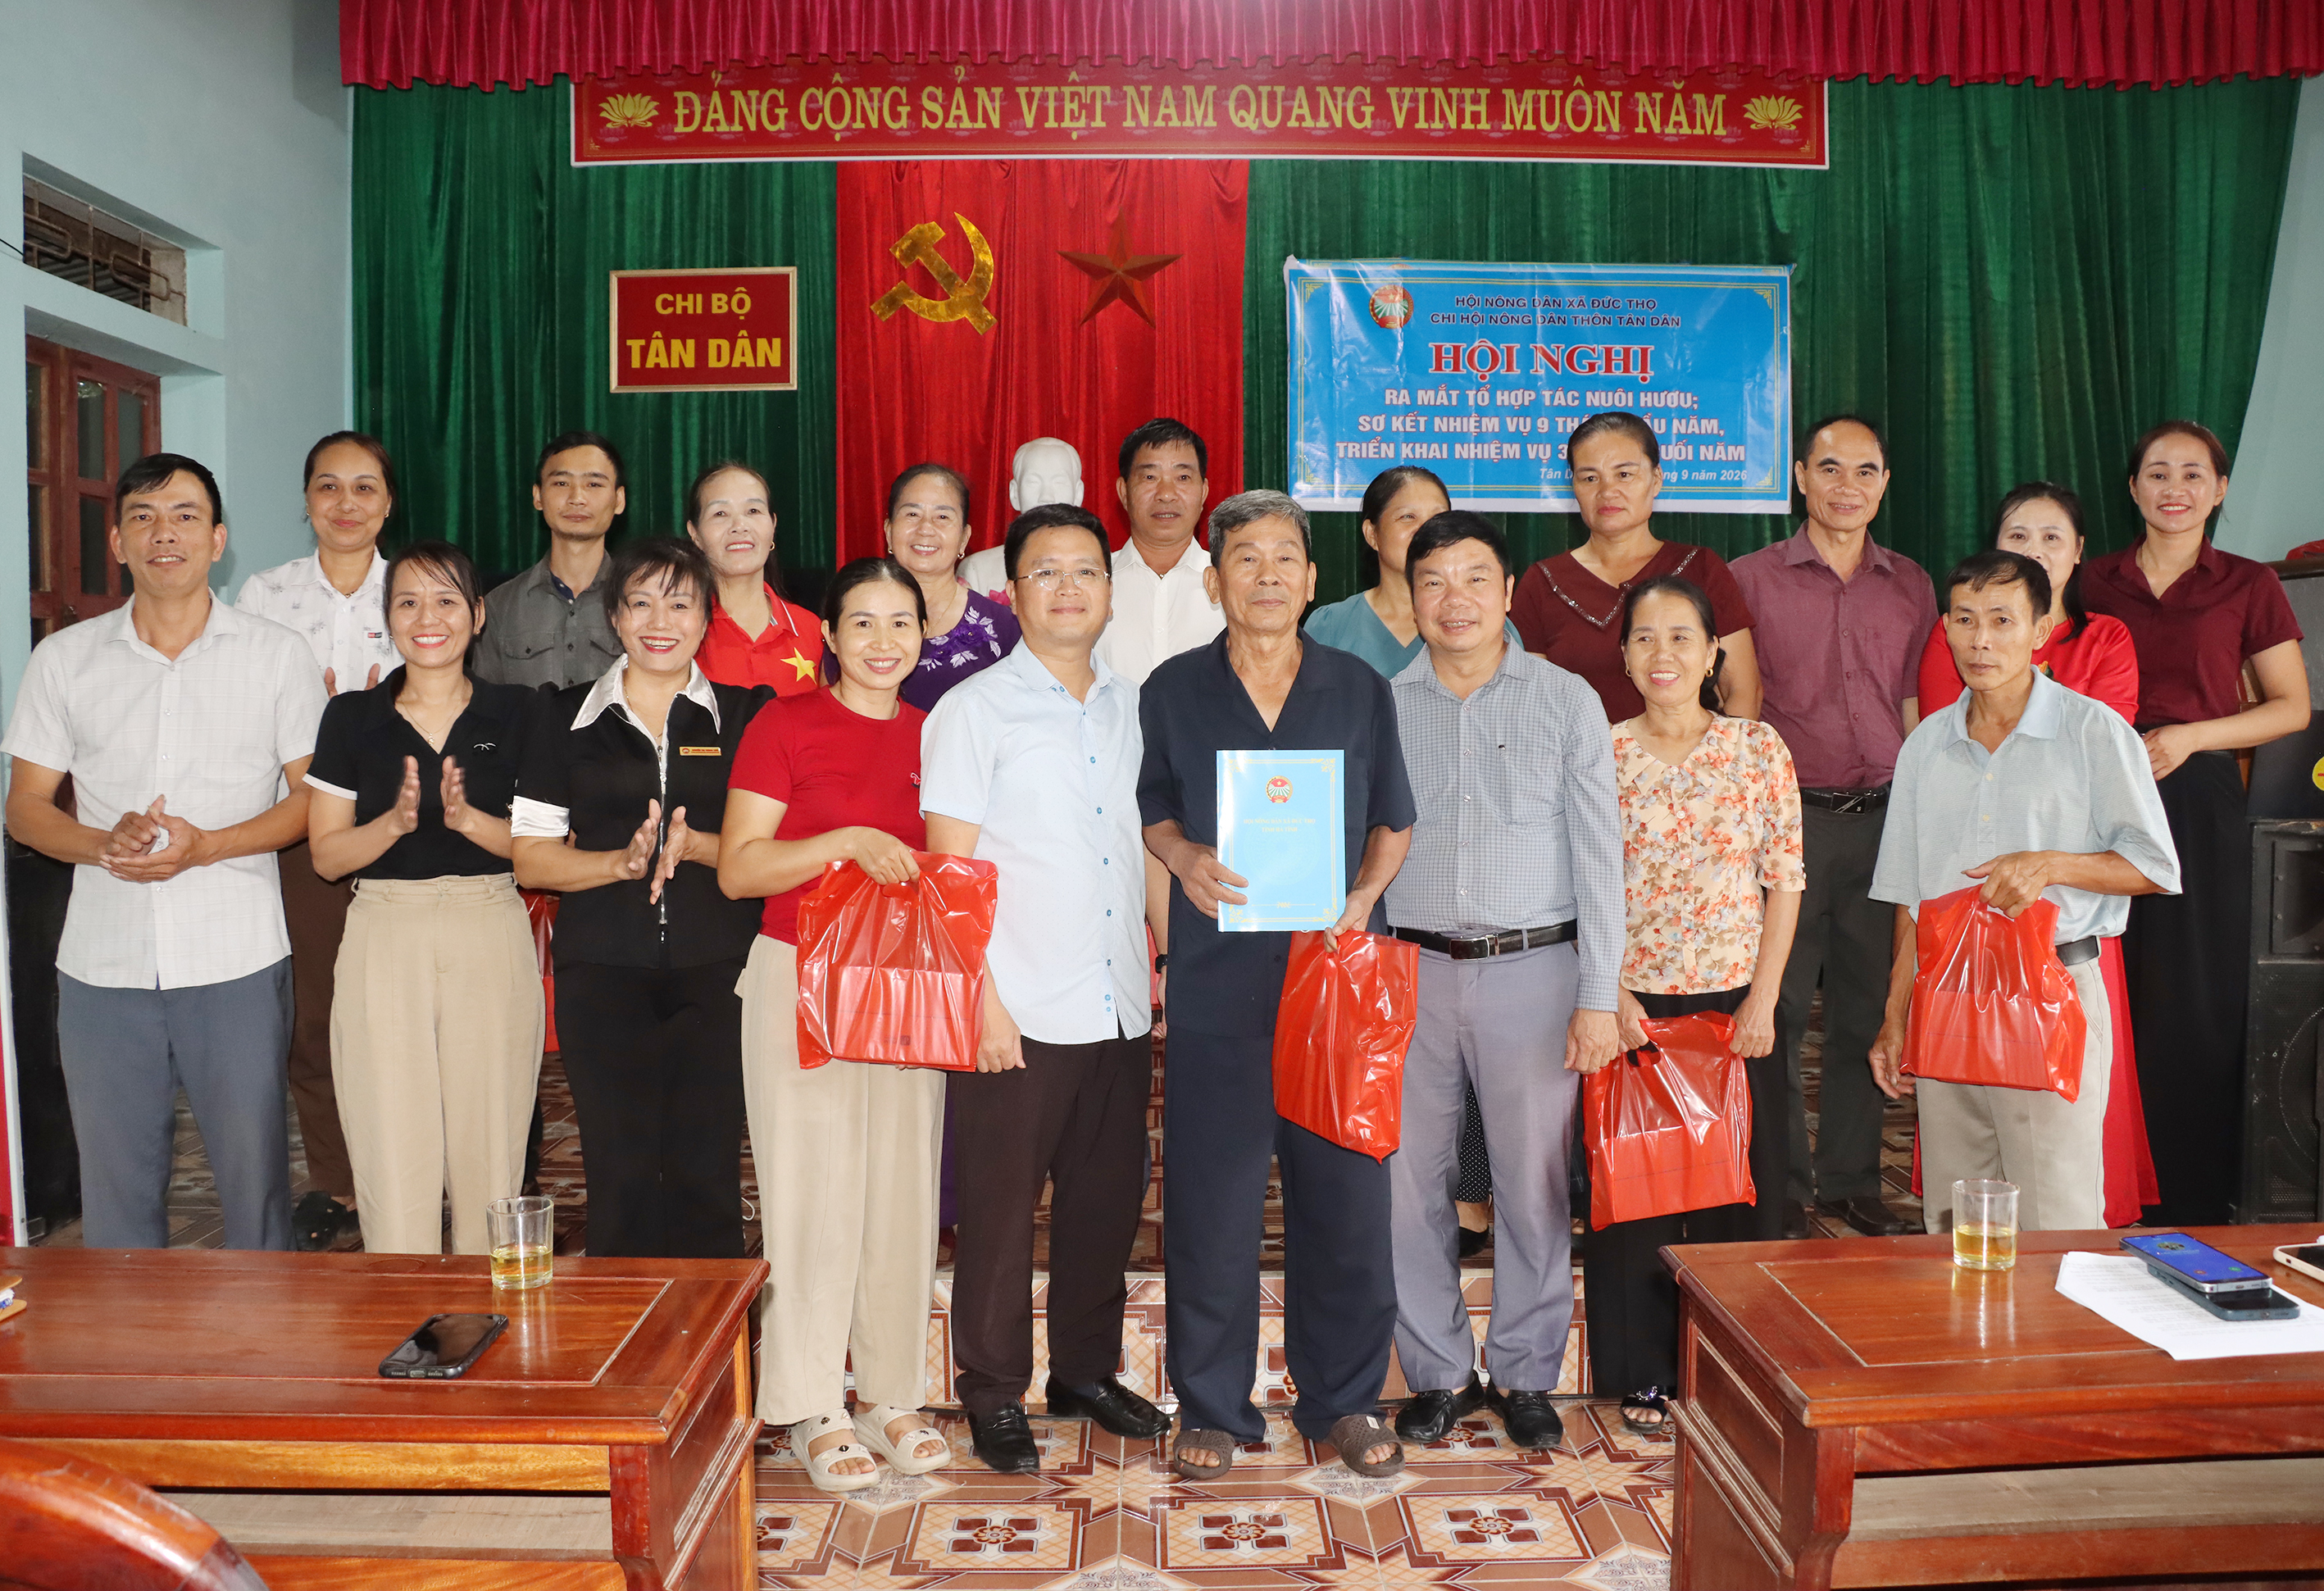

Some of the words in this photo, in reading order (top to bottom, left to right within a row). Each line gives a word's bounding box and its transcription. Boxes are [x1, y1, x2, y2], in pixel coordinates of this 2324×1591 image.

[674, 70, 788, 132] ĐẢNG
[799, 72, 910, 141] CỘNG
[921, 65, 1003, 130] SẢN
[1016, 70, 1111, 140] VIỆT
[1123, 85, 1217, 128] NAM
[1230, 84, 1375, 130] QUANG
[1386, 87, 1490, 130] VINH
[1502, 75, 1622, 133] MUÔN
[1635, 80, 1726, 135] NĂM
[655, 293, 703, 314] CHI
[712, 287, 752, 320] BỘ
[1455, 293, 1480, 310] HỘI
[1485, 295, 1527, 308] NÔNG
[1532, 295, 1562, 309] DÂN
[1567, 295, 1586, 309] XÃ
[1591, 295, 1621, 310] ĐỨC
[1626, 298, 1657, 311] THỌ
[1430, 313, 1455, 325] CHI
[1460, 311, 1485, 326] HỘI
[1489, 313, 1532, 325] NÔNG
[1536, 313, 1567, 325] DÂN
[1571, 313, 1612, 326] THÔN
[1617, 313, 1646, 326] TÂN
[1650, 314, 1681, 327] DÂN
[626, 331, 695, 368] TÂN
[708, 330, 781, 367] DÂN
[1429, 339, 1520, 382] HỘI
[1530, 343, 1654, 384] NGHỊ
[1385, 389, 1411, 406] RA
[1417, 384, 1460, 406] MẮT
[1466, 384, 1491, 407] TỔ
[1496, 389, 1536, 409] HỢP
[1542, 388, 1580, 407] TÁC
[1585, 388, 1634, 407] NUÔI
[1640, 390, 1699, 410] HƯƠU;
[1358, 413, 1386, 432] SƠ
[1392, 411, 1428, 432] KẾT
[1434, 413, 1499, 436] NHIỆM
[1506, 416, 1531, 436] VỤ
[1537, 417, 1549, 433] 9
[1672, 415, 1725, 436] NĂM,
[1335, 435, 1395, 458] TRIỂN
[1401, 443, 1449, 459] KHAI
[1454, 439, 1521, 462] NHIỆM
[1526, 443, 1552, 463] VỤ
[1558, 443, 1568, 460] 3
[1659, 439, 1694, 461] UỐI
[1699, 442, 1745, 461] NĂM
[1540, 468, 1562, 479] Tân
[1681, 469, 1689, 480] 9
[1691, 470, 1717, 480] năm
[1720, 470, 1748, 480] 2026
